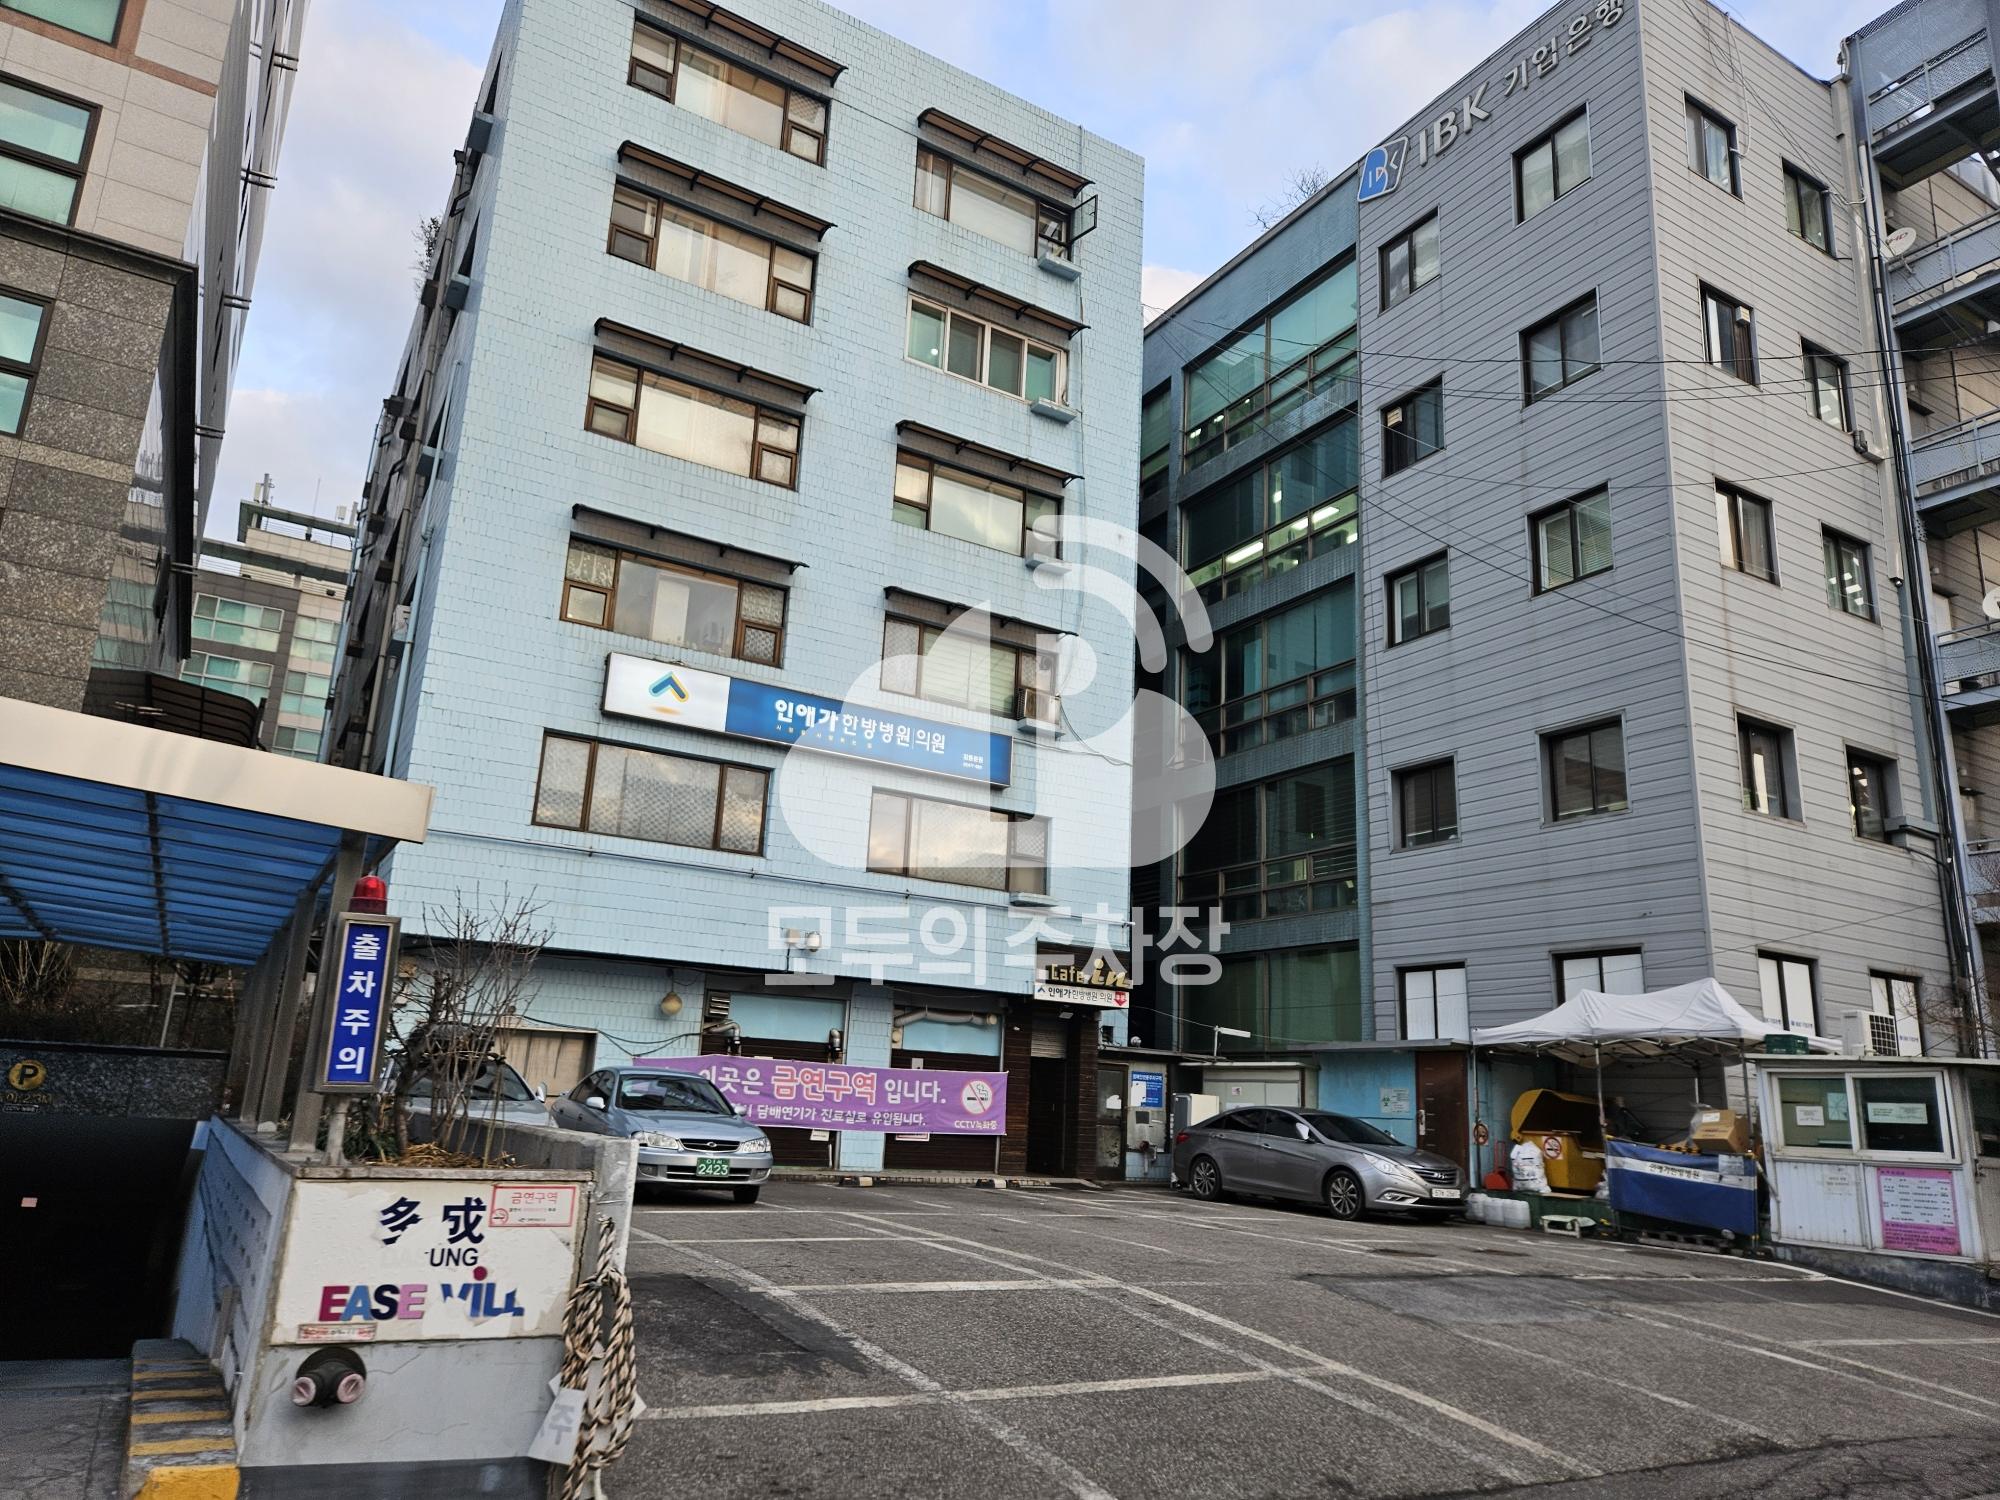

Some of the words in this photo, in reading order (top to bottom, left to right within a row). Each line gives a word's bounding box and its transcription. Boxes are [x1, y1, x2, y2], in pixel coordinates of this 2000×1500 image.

[1418, 81, 1492, 167] IBK
[1503, 0, 1624, 96] 기업은행
[916, 729, 945, 754] 의원
[335, 933, 381, 1074] 출차주의
[770, 1065, 877, 1106] 금연구역
[884, 1079, 947, 1104] 입니다.
[757, 1105, 816, 1121] 담배연기가
[821, 1109, 867, 1124] 진료실로
[871, 1112, 926, 1126] 유입됩니다.
[698, 1164, 728, 1175] 2423
[511, 1192, 558, 1205] 금연구역
[319, 1284, 428, 1321] EASE
